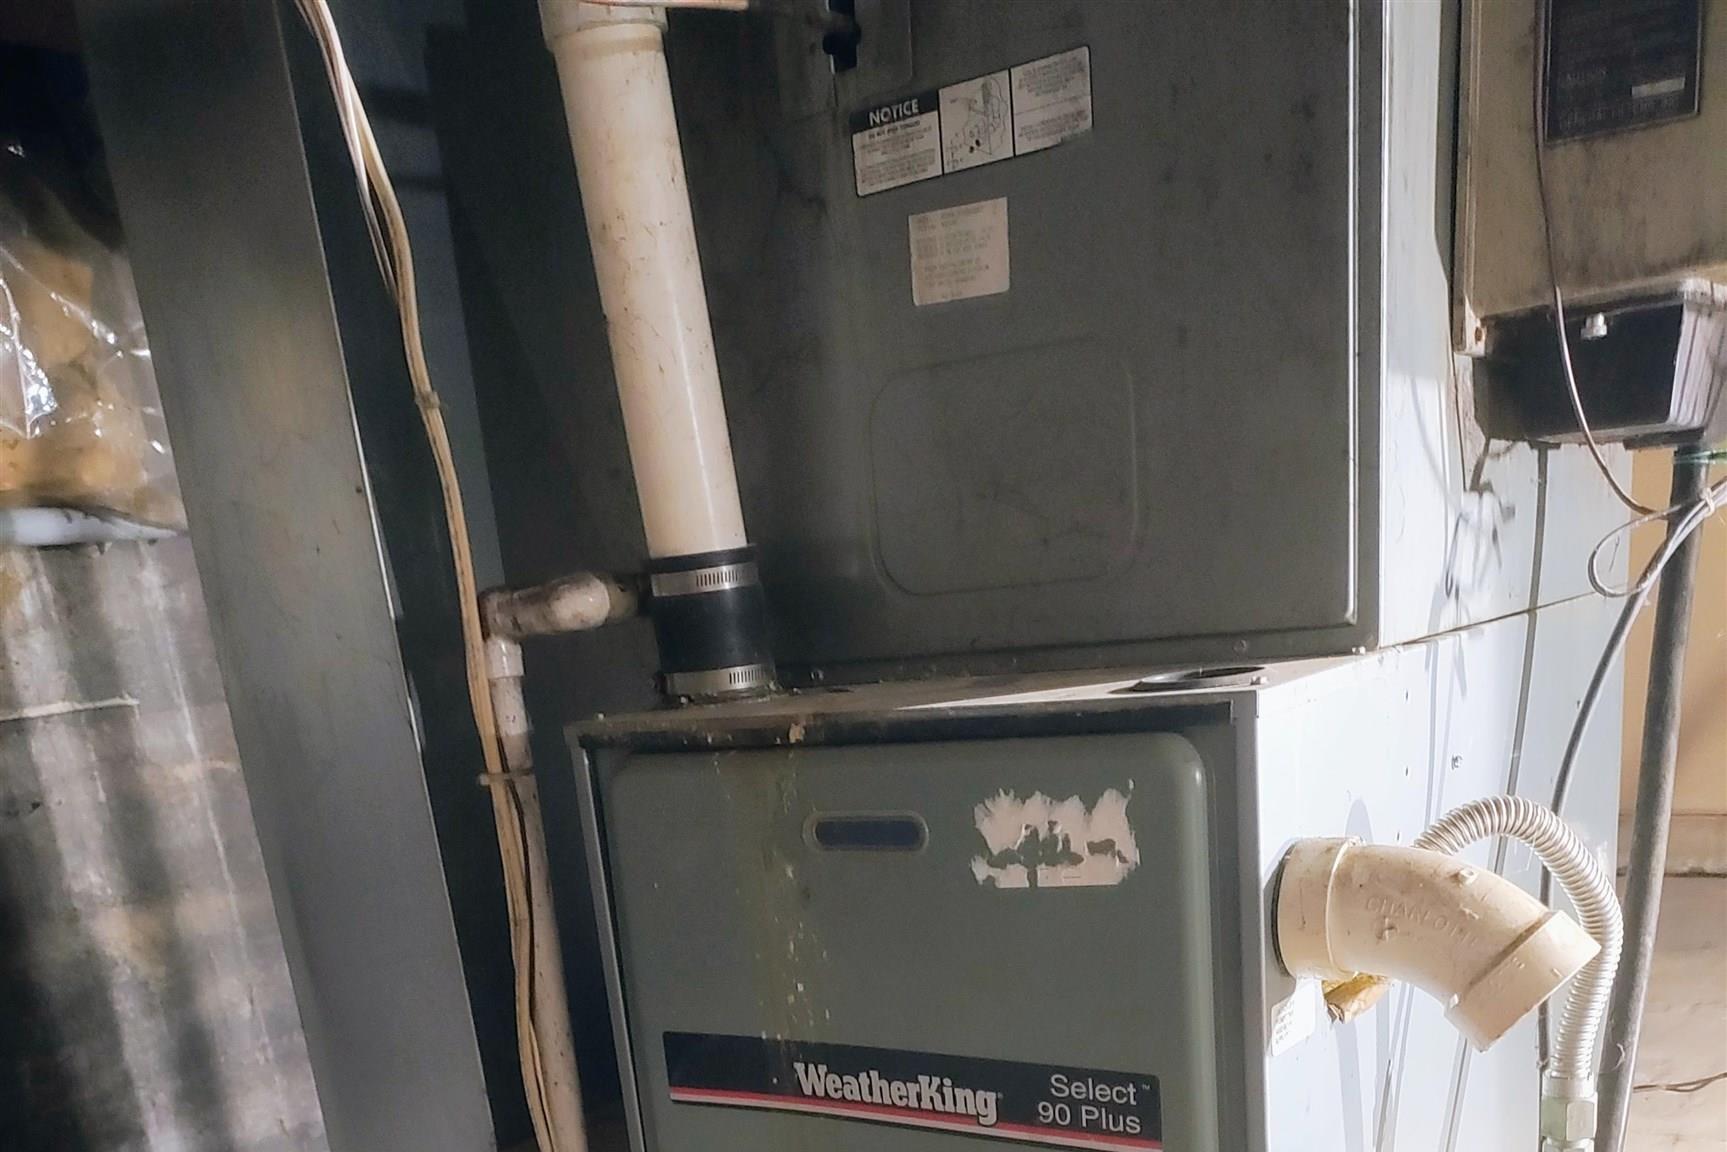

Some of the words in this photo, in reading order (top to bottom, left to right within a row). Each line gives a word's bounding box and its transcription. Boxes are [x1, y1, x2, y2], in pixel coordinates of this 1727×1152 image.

[869, 99, 919, 126] NOTICE
[793, 1060, 1000, 1126] WeatherKing
[1037, 1101, 1073, 1126] 90
[1079, 1106, 1142, 1135] Plus
